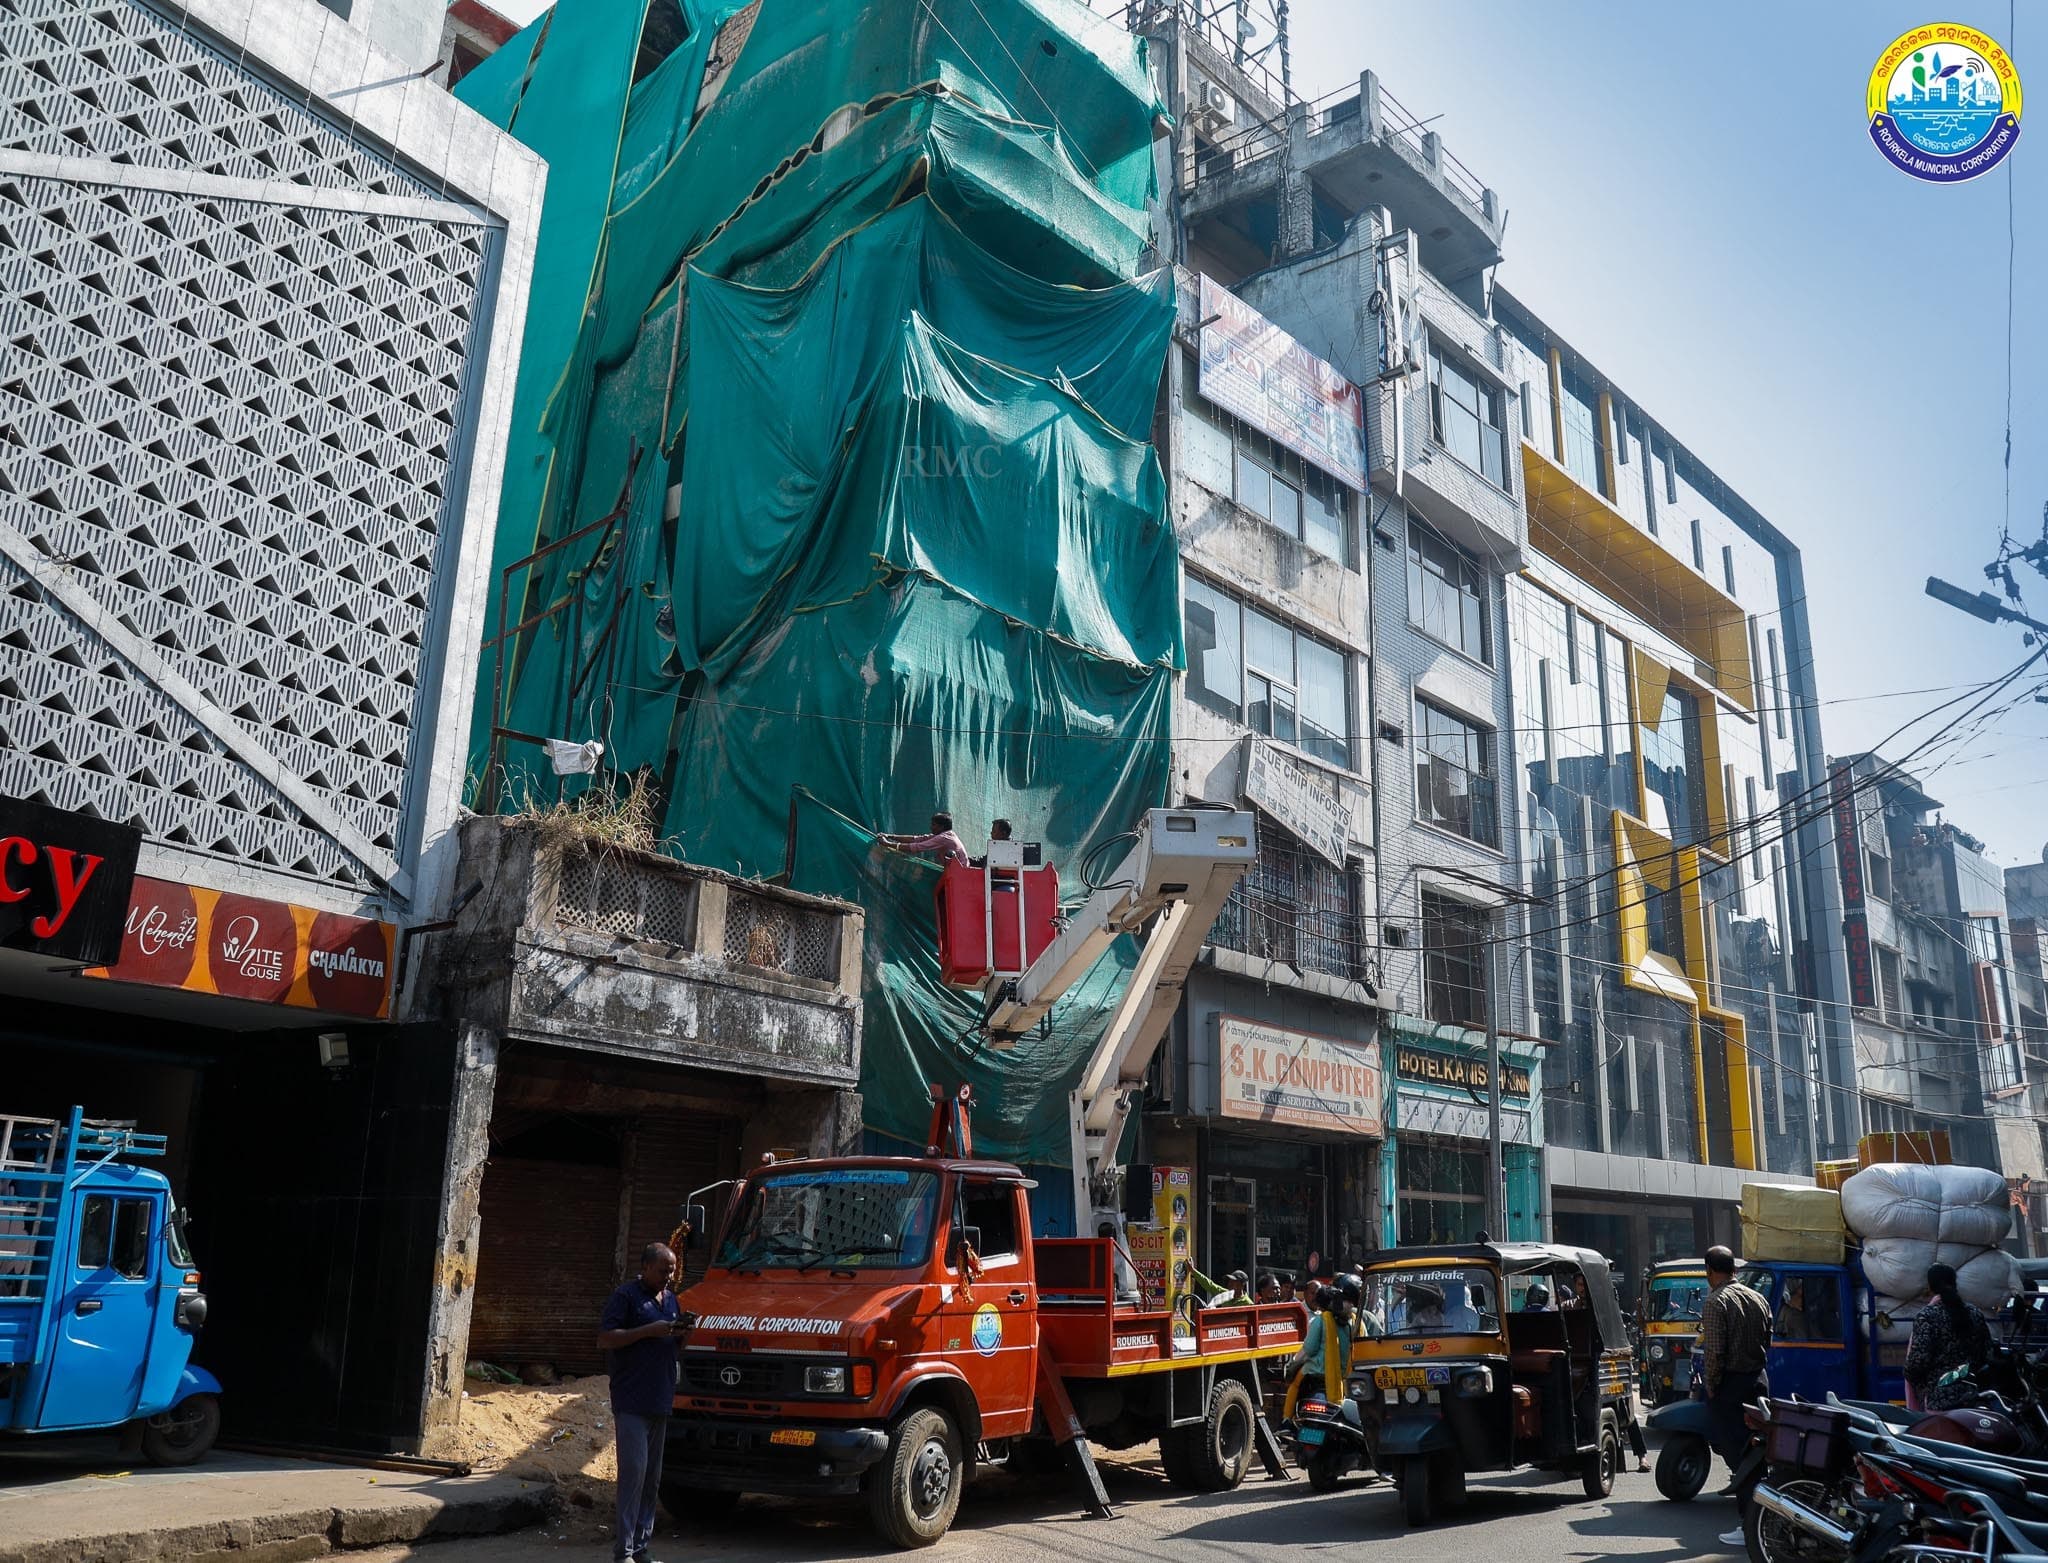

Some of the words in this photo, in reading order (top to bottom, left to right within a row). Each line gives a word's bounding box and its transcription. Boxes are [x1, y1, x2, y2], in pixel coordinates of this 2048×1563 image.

[1254, 741, 1282, 773] BLUE
[1283, 765, 1308, 790] CHIP
[1309, 783, 1350, 826] INFOSYS
[125, 906, 197, 955] Mehendi
[309, 946, 385, 979] CHANAKYA
[1399, 1052, 1443, 1079] HOTEL
[1285, 1096, 1316, 1109] SERVICES
[1320, 1101, 1348, 1113] SUPPORT
[702, 1315, 757, 1331] MUNICIPAL
[758, 1317, 843, 1335] CORPORATION
[1116, 1334, 1155, 1347] ROURKELA
[1207, 1326, 1240, 1339] MUNICIPAL
[1258, 1321, 1297, 1333] CORPORATION
[1377, 1378, 1394, 1387] 581
